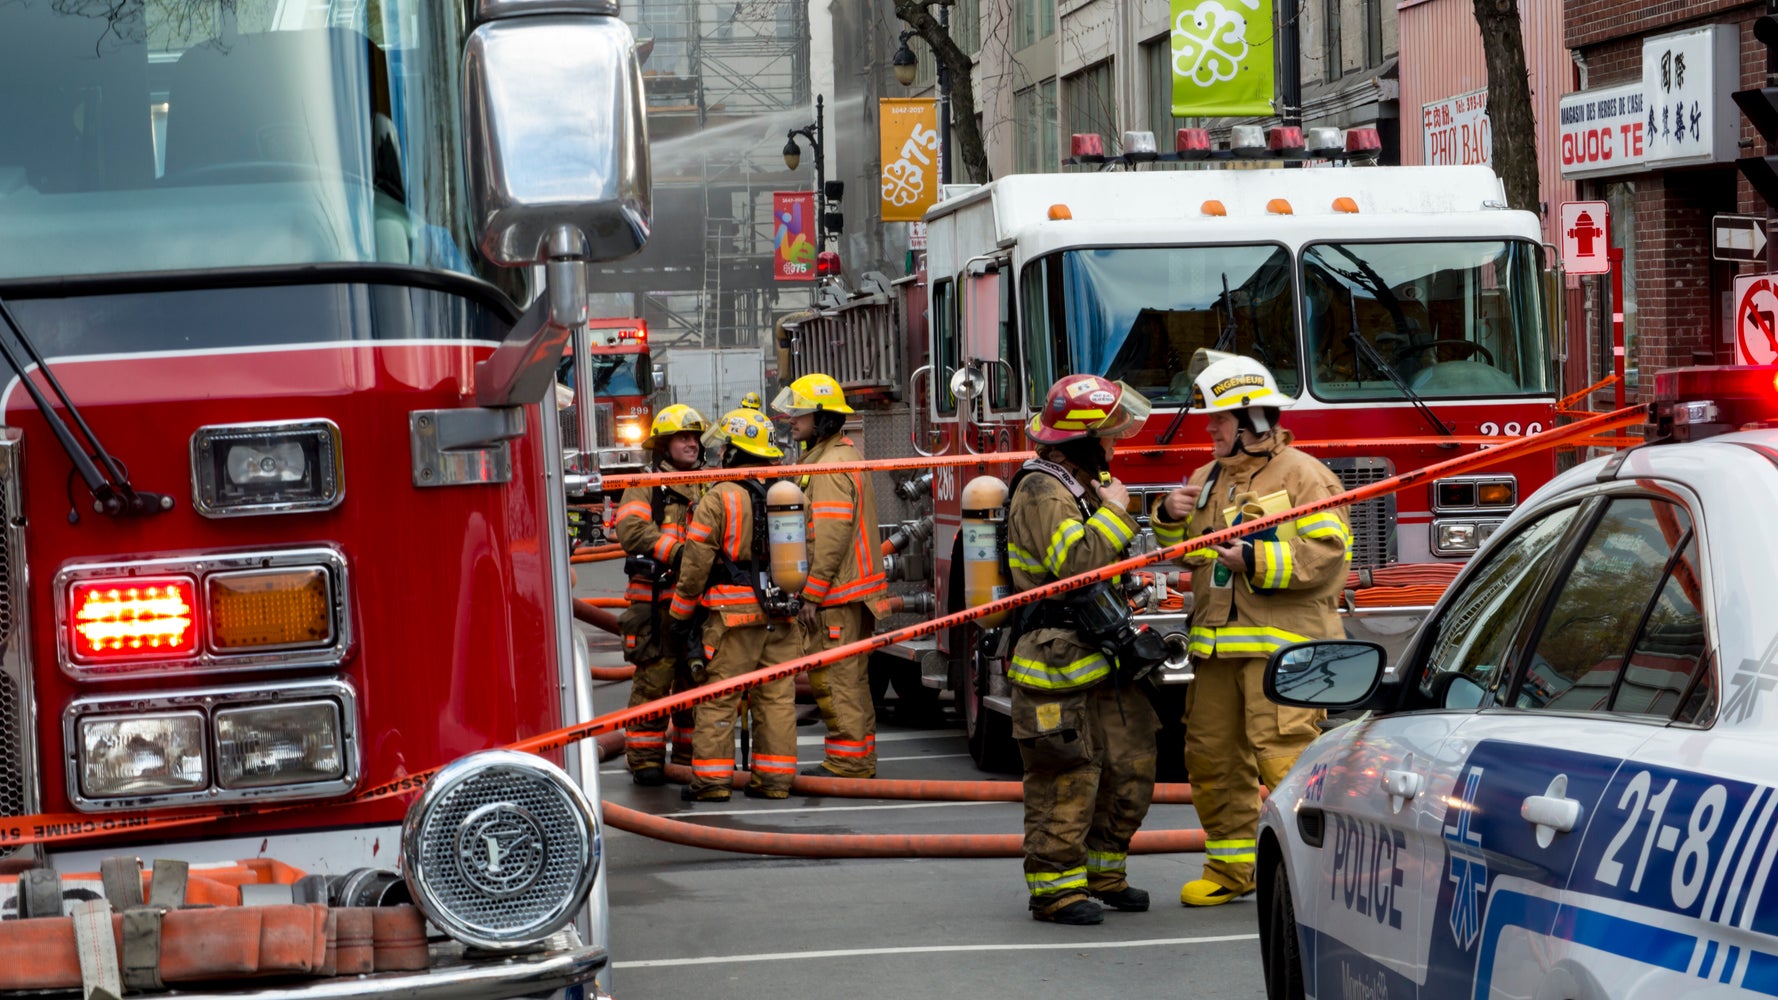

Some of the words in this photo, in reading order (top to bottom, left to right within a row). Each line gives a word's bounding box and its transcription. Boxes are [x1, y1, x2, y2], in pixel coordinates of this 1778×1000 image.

[1561, 104, 1585, 126] MAGASIN
[1586, 101, 1596, 121] DES
[1597, 97, 1617, 119] HERBES
[1619, 96, 1626, 116] DE
[1562, 127, 1613, 166] QUOC
[1620, 121, 1644, 158] TE
[630, 407, 649, 415] 299
[937, 464, 955, 501] 286
[1052, 573, 1101, 594] POLICE
[981, 589, 1049, 616] PASSAGE
[364, 772, 434, 800] ASSAGE
[33, 816, 149, 839] INFO-CRIME
[1595, 769, 1728, 910] 21-8
[1331, 812, 1407, 930] POLICE
